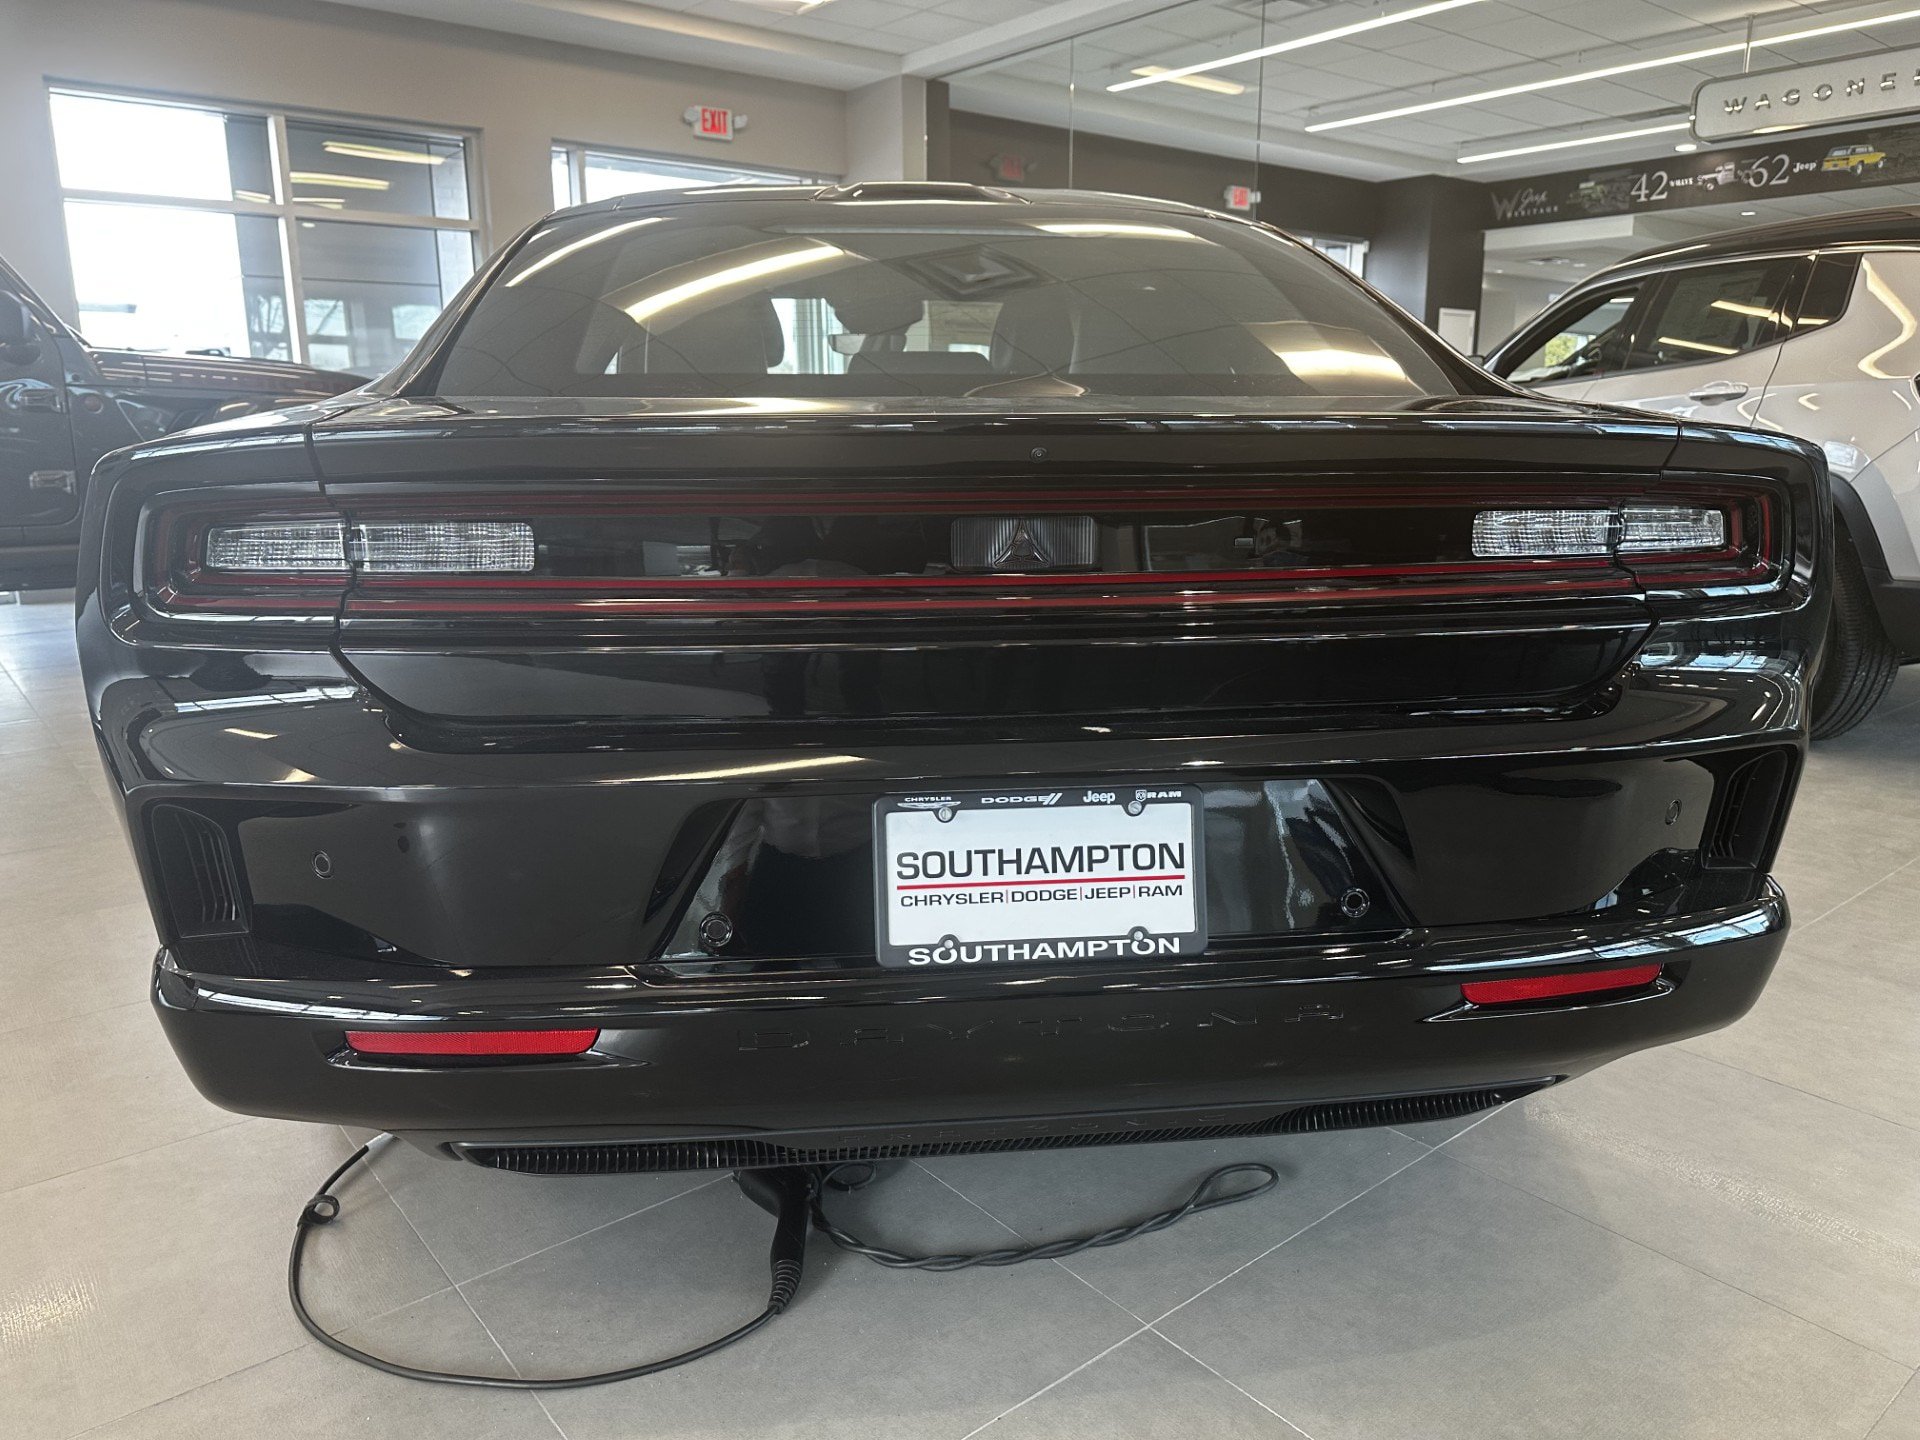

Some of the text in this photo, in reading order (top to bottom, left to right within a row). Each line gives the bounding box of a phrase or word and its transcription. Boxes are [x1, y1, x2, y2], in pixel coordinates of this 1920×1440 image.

[701, 108, 728, 135] EXIT
[1749, 154, 1816, 187] 62 Jeep
[1630, 171, 1668, 202] 42
[981, 795, 1050, 804] DODGE
[1082, 790, 1116, 804] Jeep
[1147, 790, 1182, 799] RAM
[896, 842, 1185, 880] SOUTHAMPTON
[908, 937, 1181, 967] SOUTHAMPTON
[737, 1002, 1345, 1051] DAYTONA
